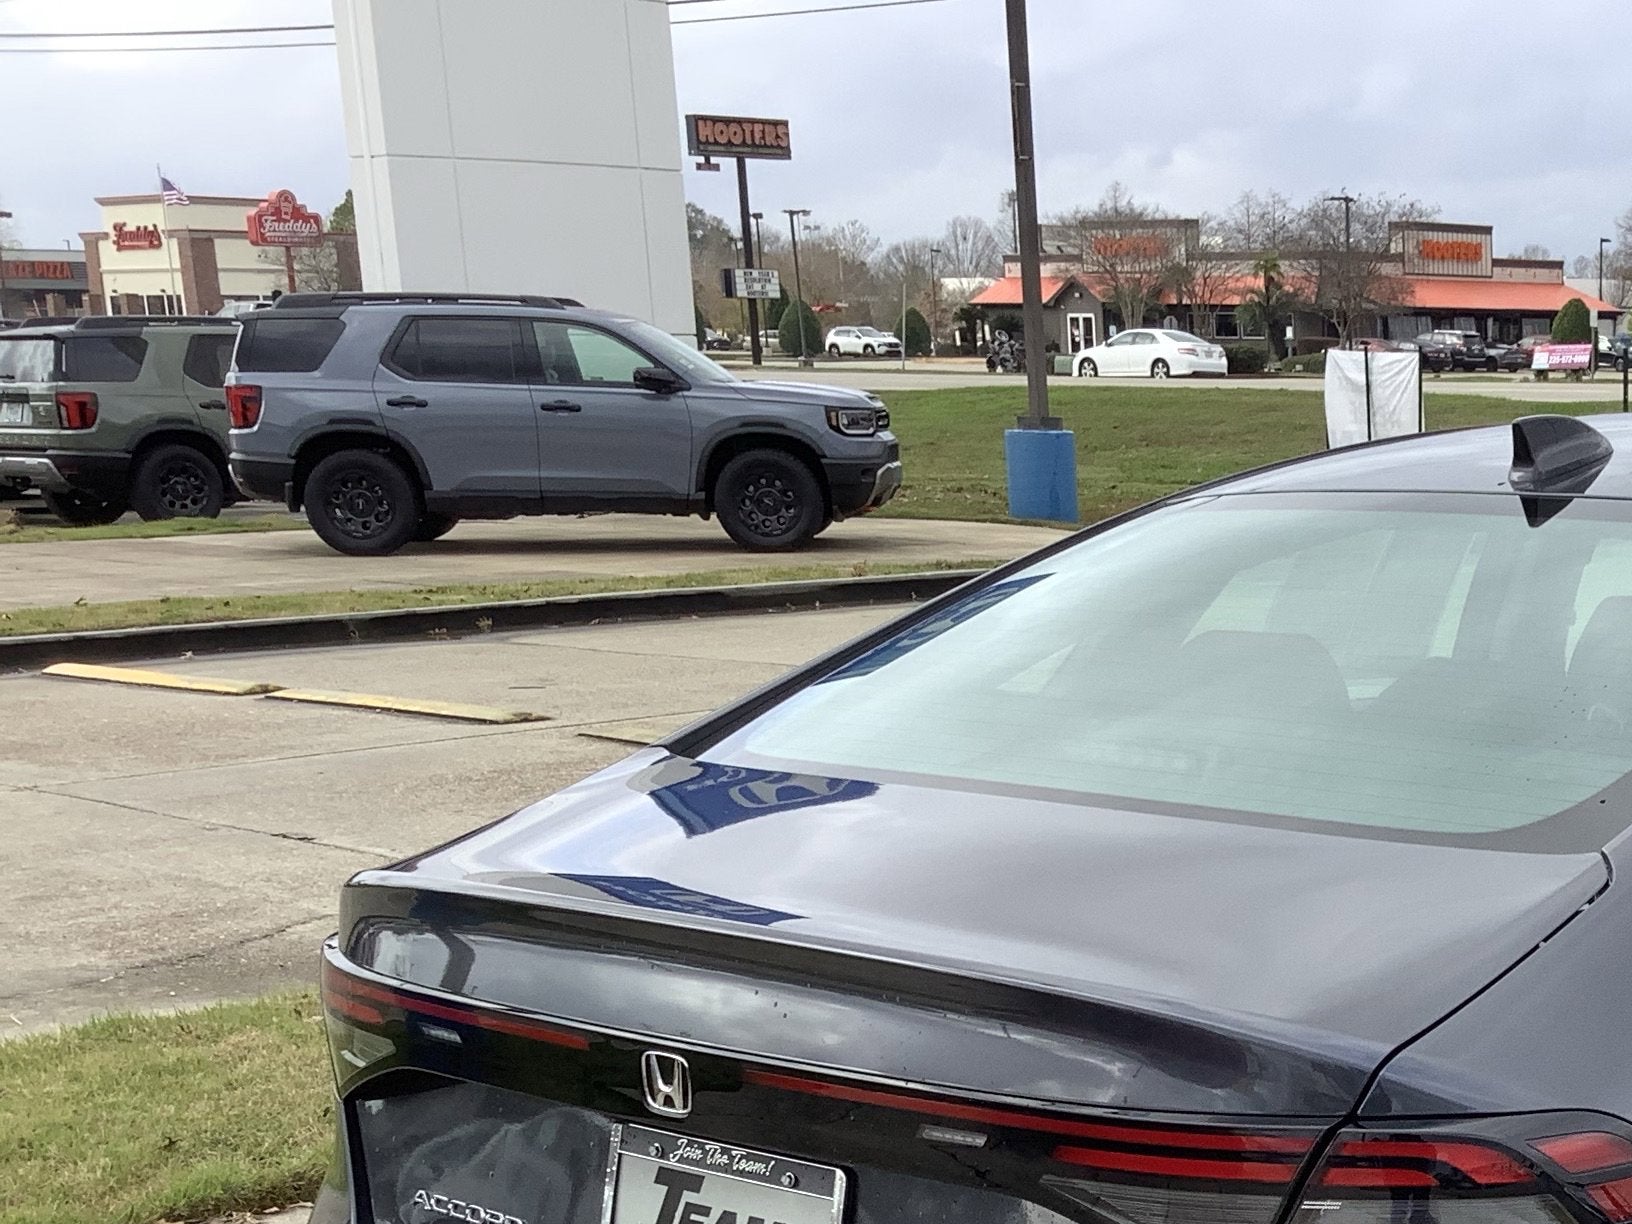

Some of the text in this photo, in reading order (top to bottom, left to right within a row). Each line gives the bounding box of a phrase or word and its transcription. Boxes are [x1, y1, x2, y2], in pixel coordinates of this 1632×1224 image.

[697, 119, 789, 147] HOOTERS
[260, 215, 319, 237] Freddy's
[1421, 239, 1483, 262] HOOTERS
[34, 261, 72, 279] PIZZA
[669, 1138, 775, 1176] Join The Team!
